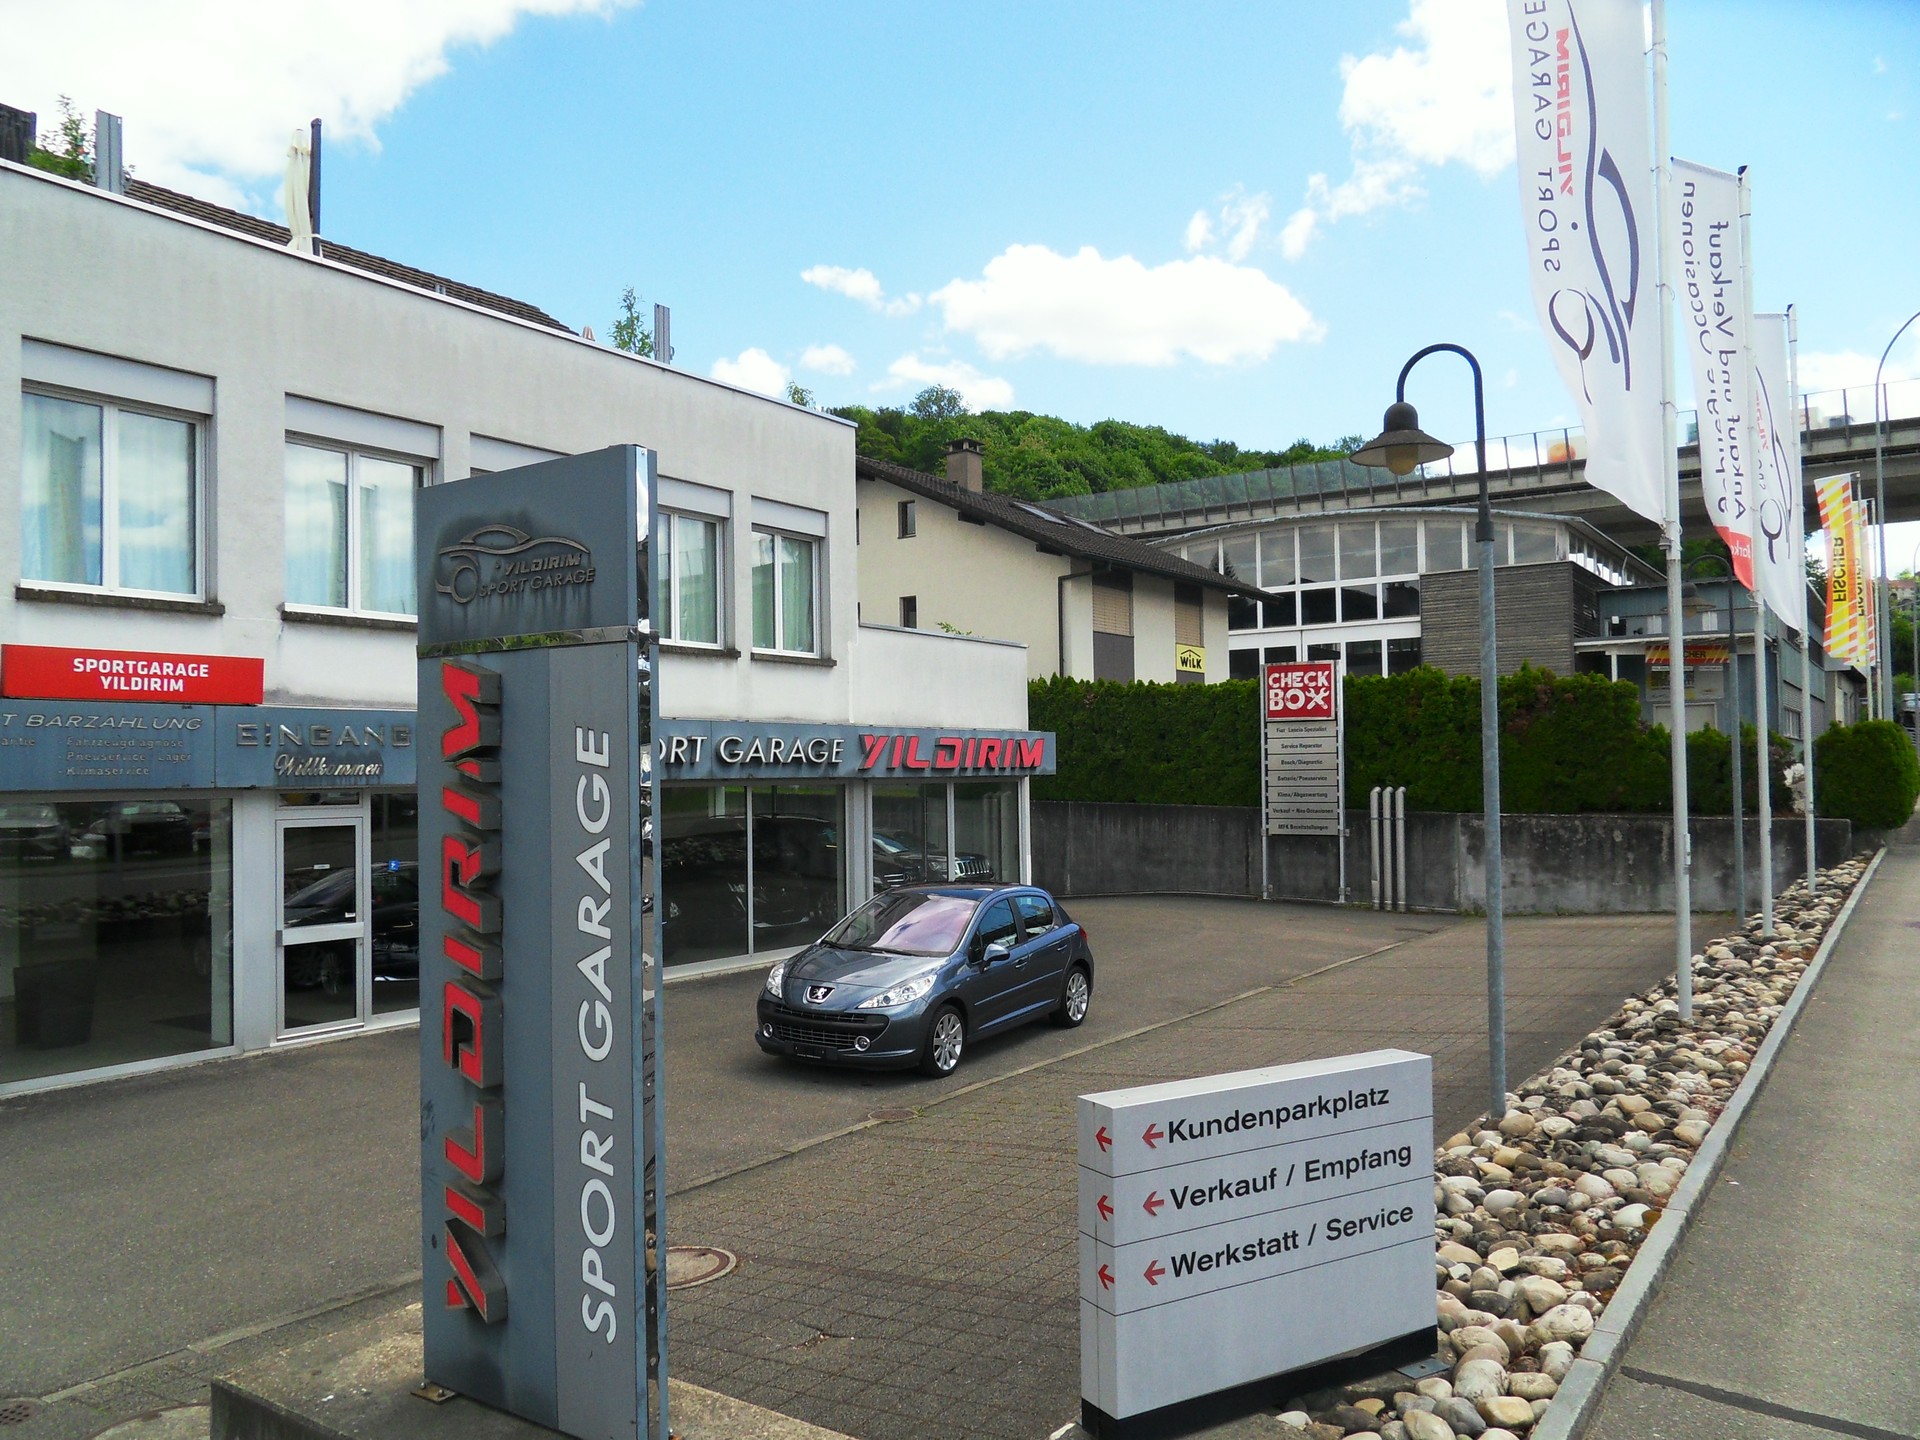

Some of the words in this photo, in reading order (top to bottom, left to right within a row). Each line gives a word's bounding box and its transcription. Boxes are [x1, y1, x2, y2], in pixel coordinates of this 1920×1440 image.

[505, 552, 582, 576] YILDIRIM
[478, 578, 528, 597] SPORT
[530, 567, 595, 590] GARAGE
[73, 657, 209, 678] SPORTGARAGE
[100, 674, 184, 692] YILDIRIM
[1268, 670, 1330, 688] CHECK
[25, 714, 201, 730] BARZAHLUNG
[274, 753, 383, 776] Willkommen
[719, 736, 844, 764] GARAGE
[858, 734, 1045, 770] YILDIRIM
[574, 725, 615, 1063] GARAGE
[440, 657, 494, 1318] YILDIRIM
[1168, 1087, 1390, 1144] Kundenparkplatz
[1169, 1168, 1278, 1211] Verkauf
[1304, 1145, 1412, 1184] Empfang
[580, 1097, 616, 1345] SPORT
[1171, 1229, 1300, 1279] Werkstatt
[1325, 1206, 1414, 1241] Service
